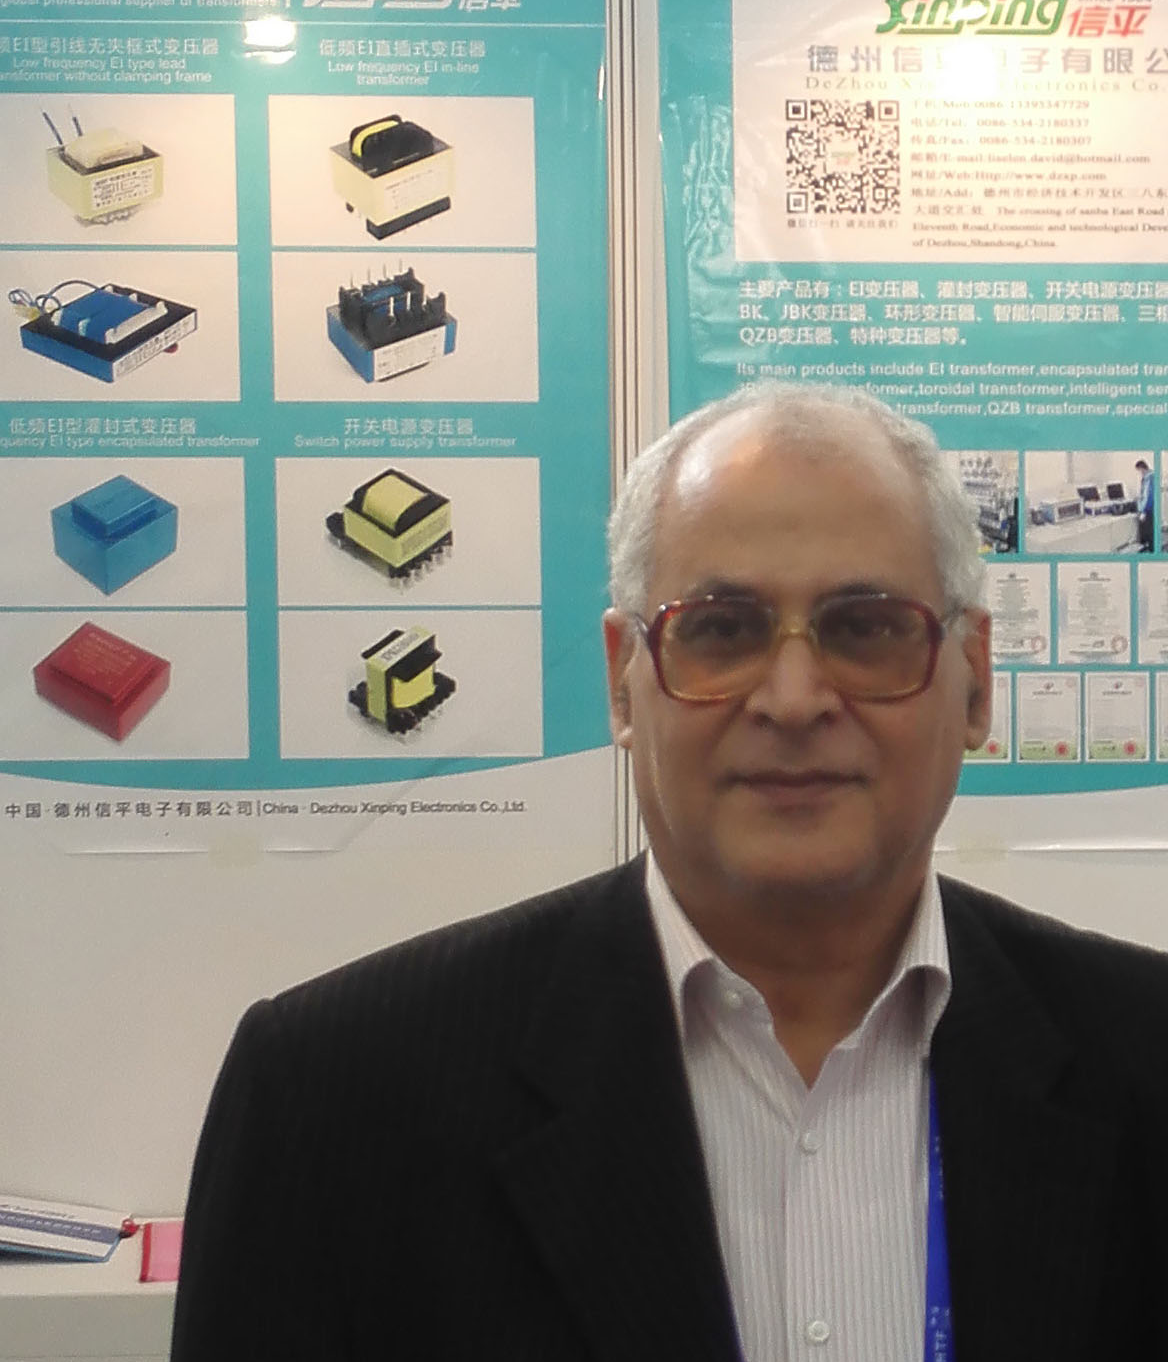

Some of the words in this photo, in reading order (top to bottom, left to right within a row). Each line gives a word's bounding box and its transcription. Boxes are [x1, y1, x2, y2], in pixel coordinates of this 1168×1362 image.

[1068, 4, 1153, 39] 信平
[13, 57, 39, 69] Low
[43, 57, 105, 72] frequency
[128, 57, 155, 72] type
[158, 57, 186, 69] lead
[64, 70, 110, 82] without
[113, 70, 171, 85] clamping
[175, 70, 212, 82] frame
[356, 73, 430, 85] transformer
[760, 363, 796, 375] main
[801, 362, 865, 379] products
[870, 363, 923, 375] include
[344, 417, 473, 436] 开关电源变压器
[438, 435, 516, 448] transformer
[262, 801, 299, 815] China
[310, 801, 358, 815] Dezhou
[361, 801, 408, 816] Xinping
[411, 800, 477, 814] Electronics
